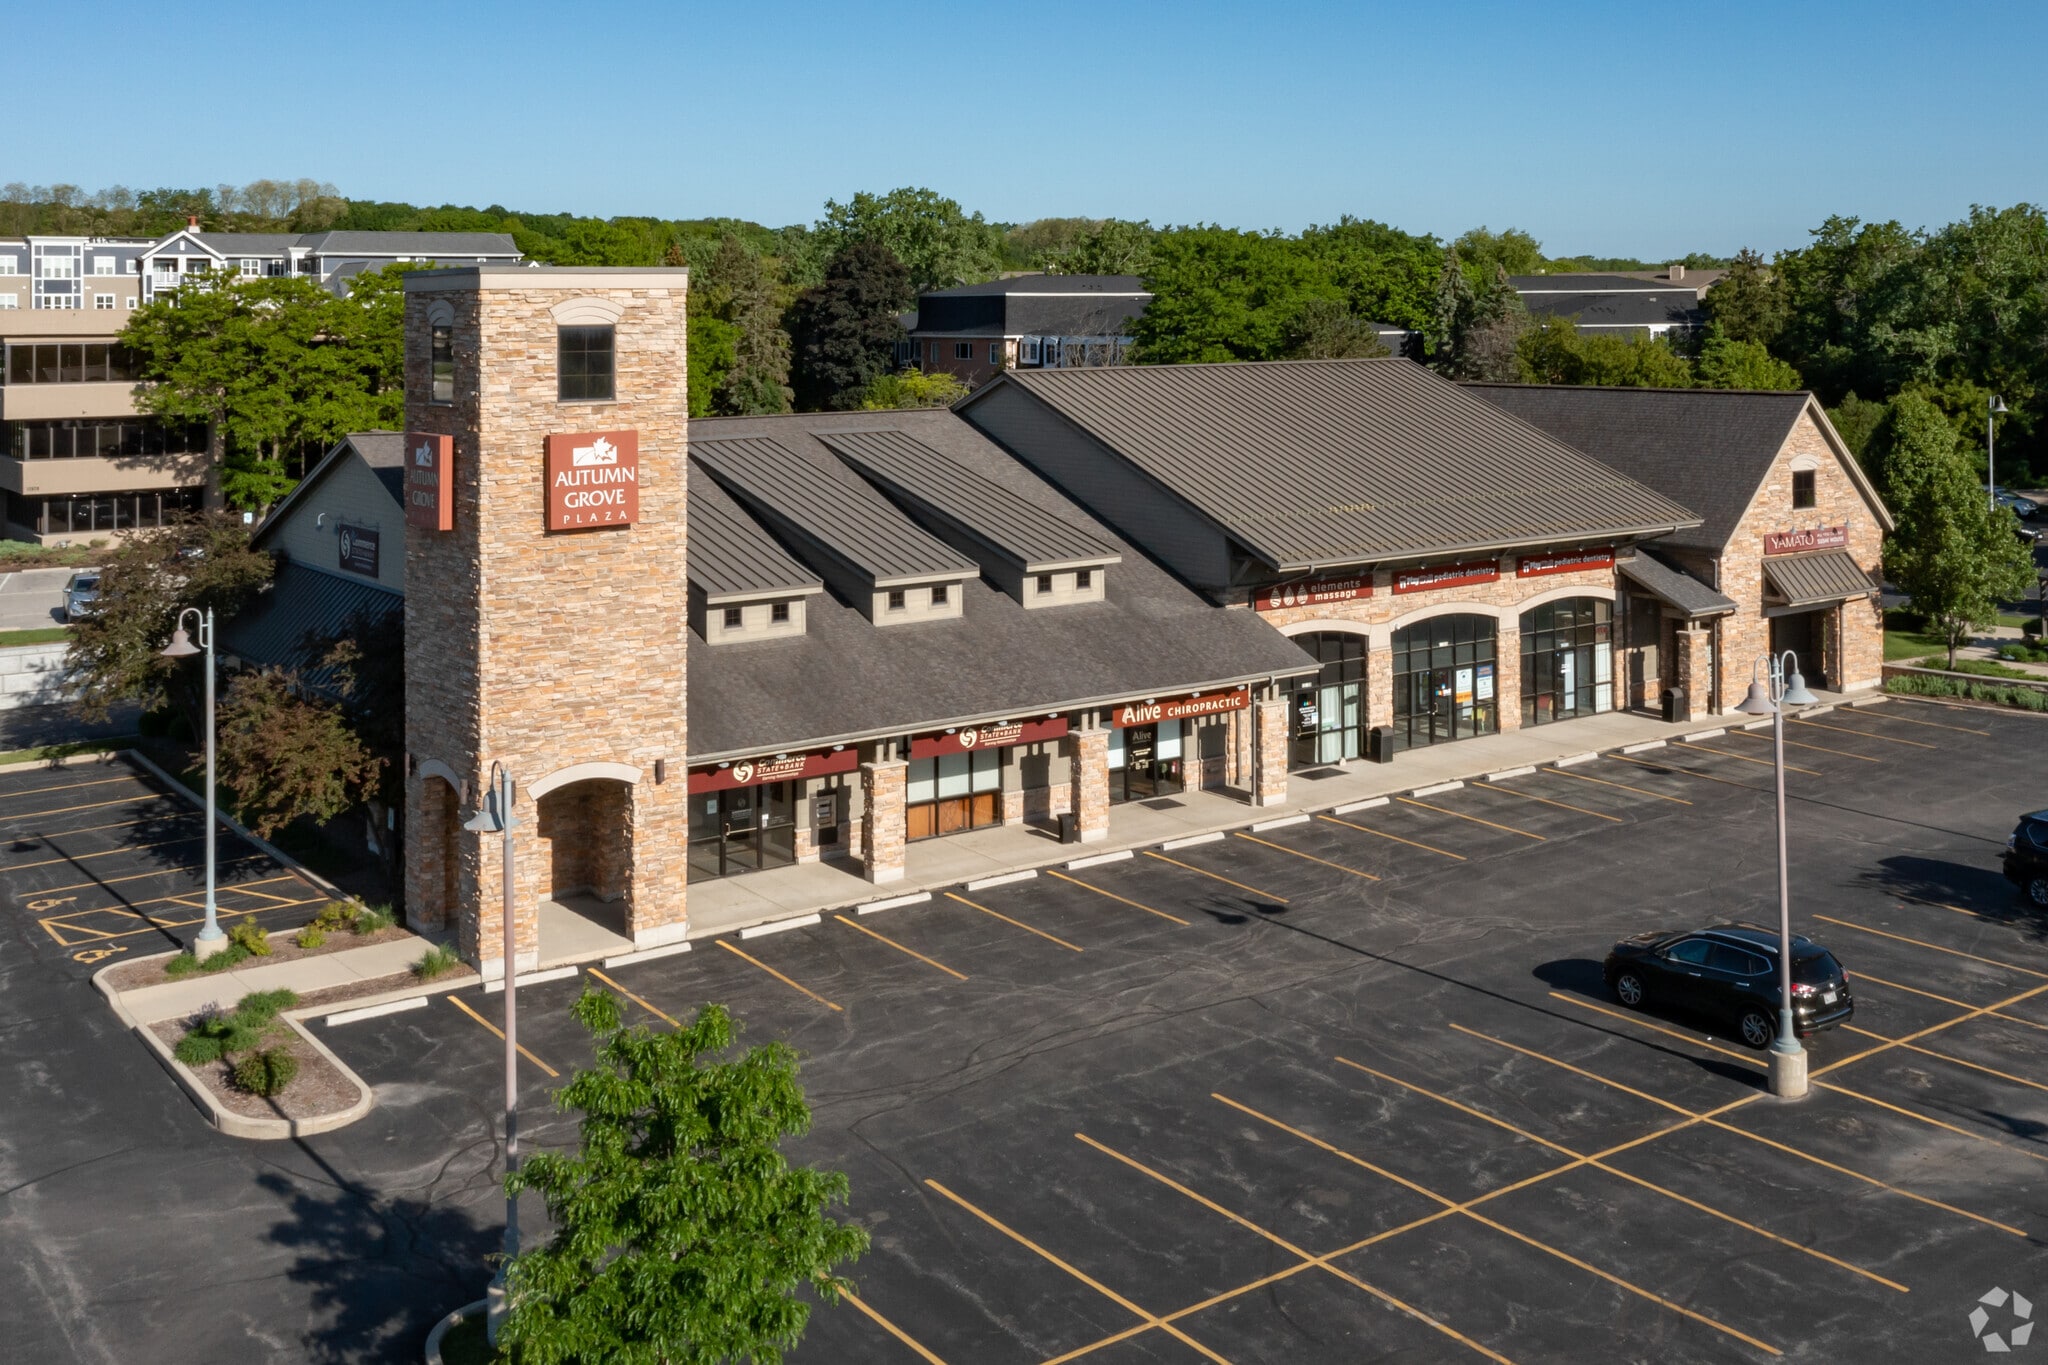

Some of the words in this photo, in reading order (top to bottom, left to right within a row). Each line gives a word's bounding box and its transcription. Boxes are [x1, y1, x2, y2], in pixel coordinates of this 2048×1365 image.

[555, 466, 635, 487] AUTUMN
[564, 489, 626, 508] GROVE
[563, 510, 627, 525] PLAZA
[1771, 534, 1814, 549] YAMATO
[1434, 571, 1464, 583] pediatric
[1465, 567, 1496, 577] dentistry
[1311, 580, 1361, 593] elements
[1315, 589, 1357, 601] massage
[1122, 704, 1161, 724] Alive
[1167, 697, 1241, 717] CHIROPRACTIC
[1132, 730, 1152, 741] Alive
[757, 764, 780, 774] STATE
[784, 761, 805, 770] BANK
